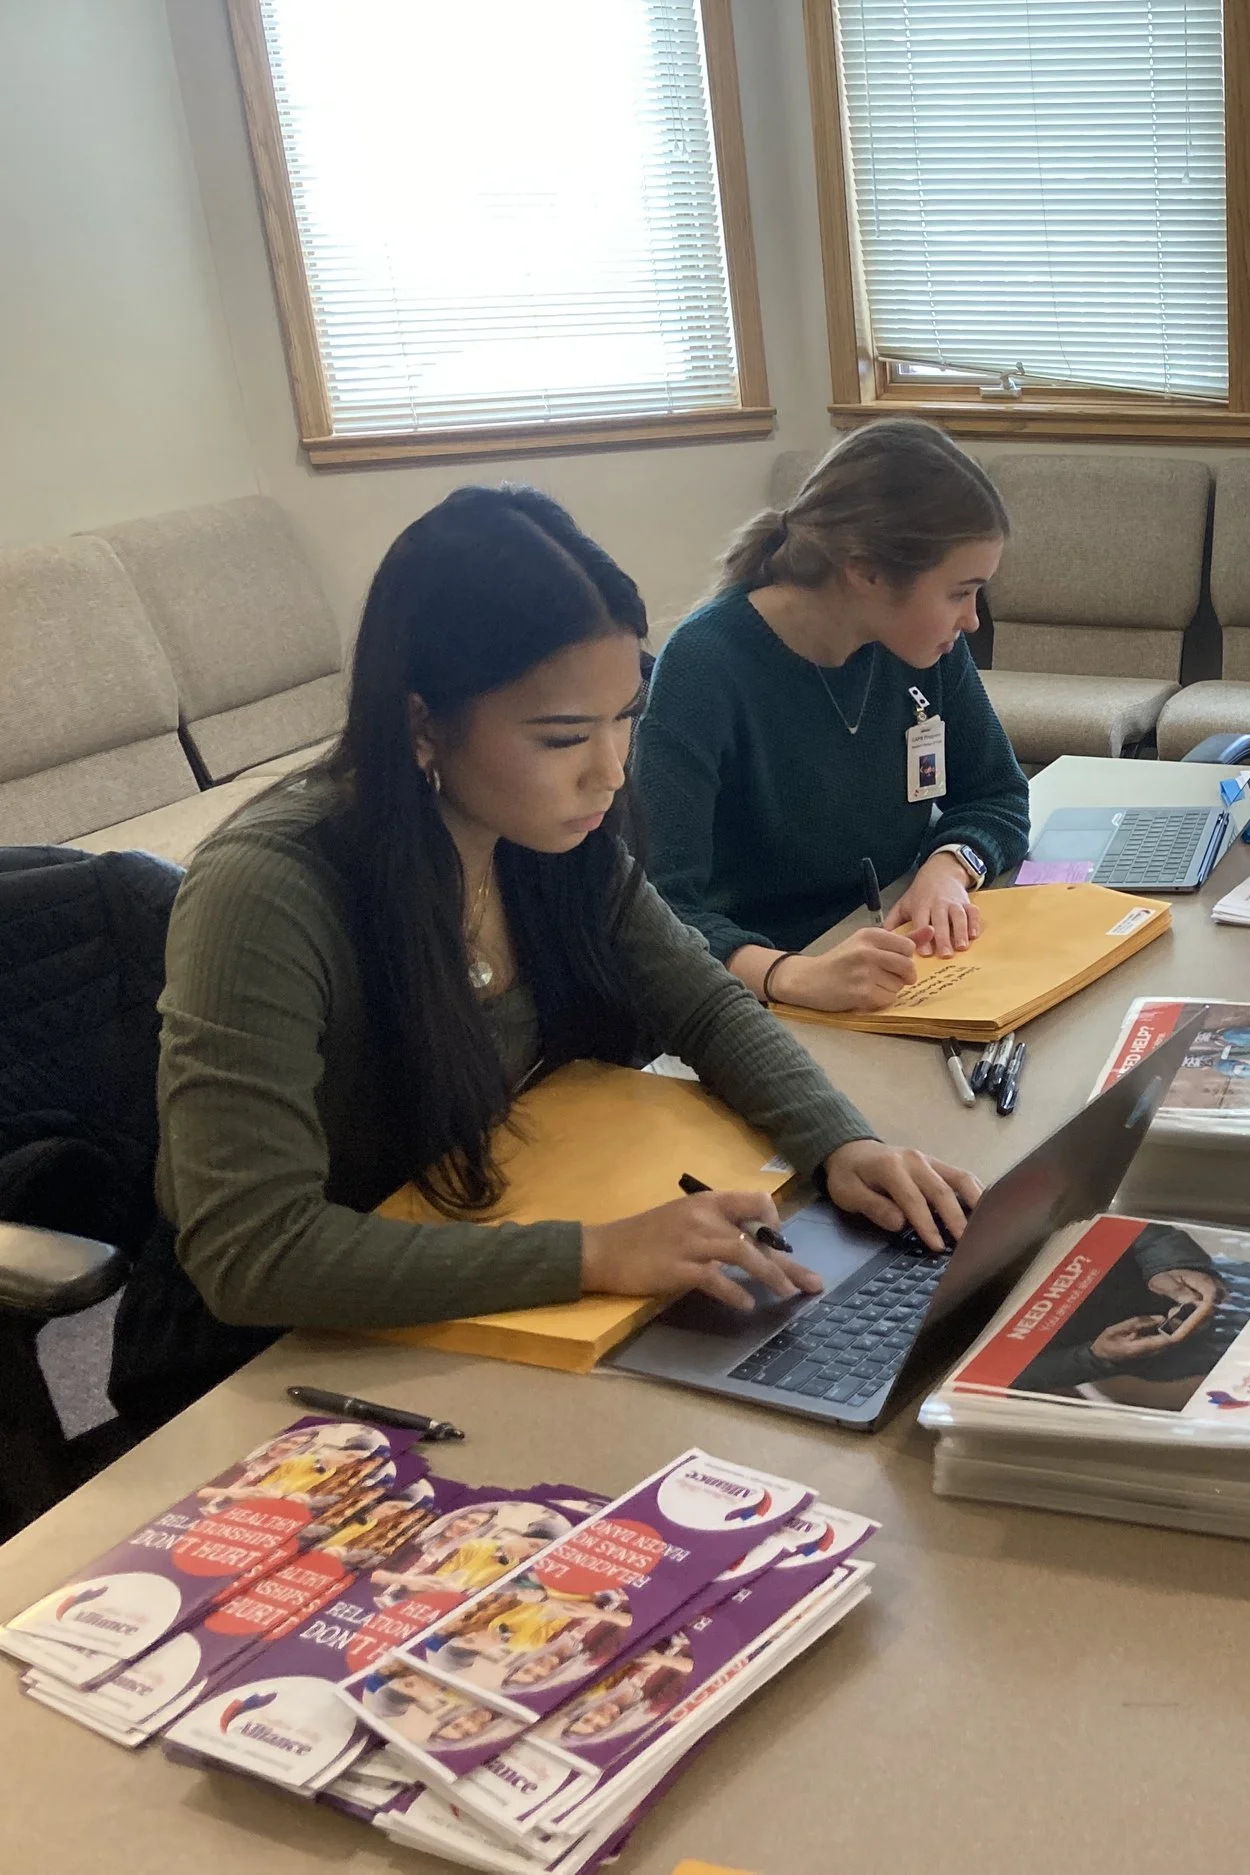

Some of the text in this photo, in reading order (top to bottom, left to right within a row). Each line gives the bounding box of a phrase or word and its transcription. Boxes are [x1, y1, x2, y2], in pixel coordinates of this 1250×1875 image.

[1129, 1025, 1155, 1053] HELP?
[1006, 1254, 1093, 1340] NEED HELP?
[156, 1513, 283, 1549] RELATIONSHIPS
[223, 1507, 301, 1533] HEALTHY
[129, 1529, 263, 1568] DON'T HURT
[552, 1545, 653, 1588] RELACIONES
[600, 1541, 653, 1569] SANAS
[635, 1536, 692, 1562] HACEN
[299, 1620, 378, 1656] DON'T
[324, 1601, 419, 1640] RELATION
